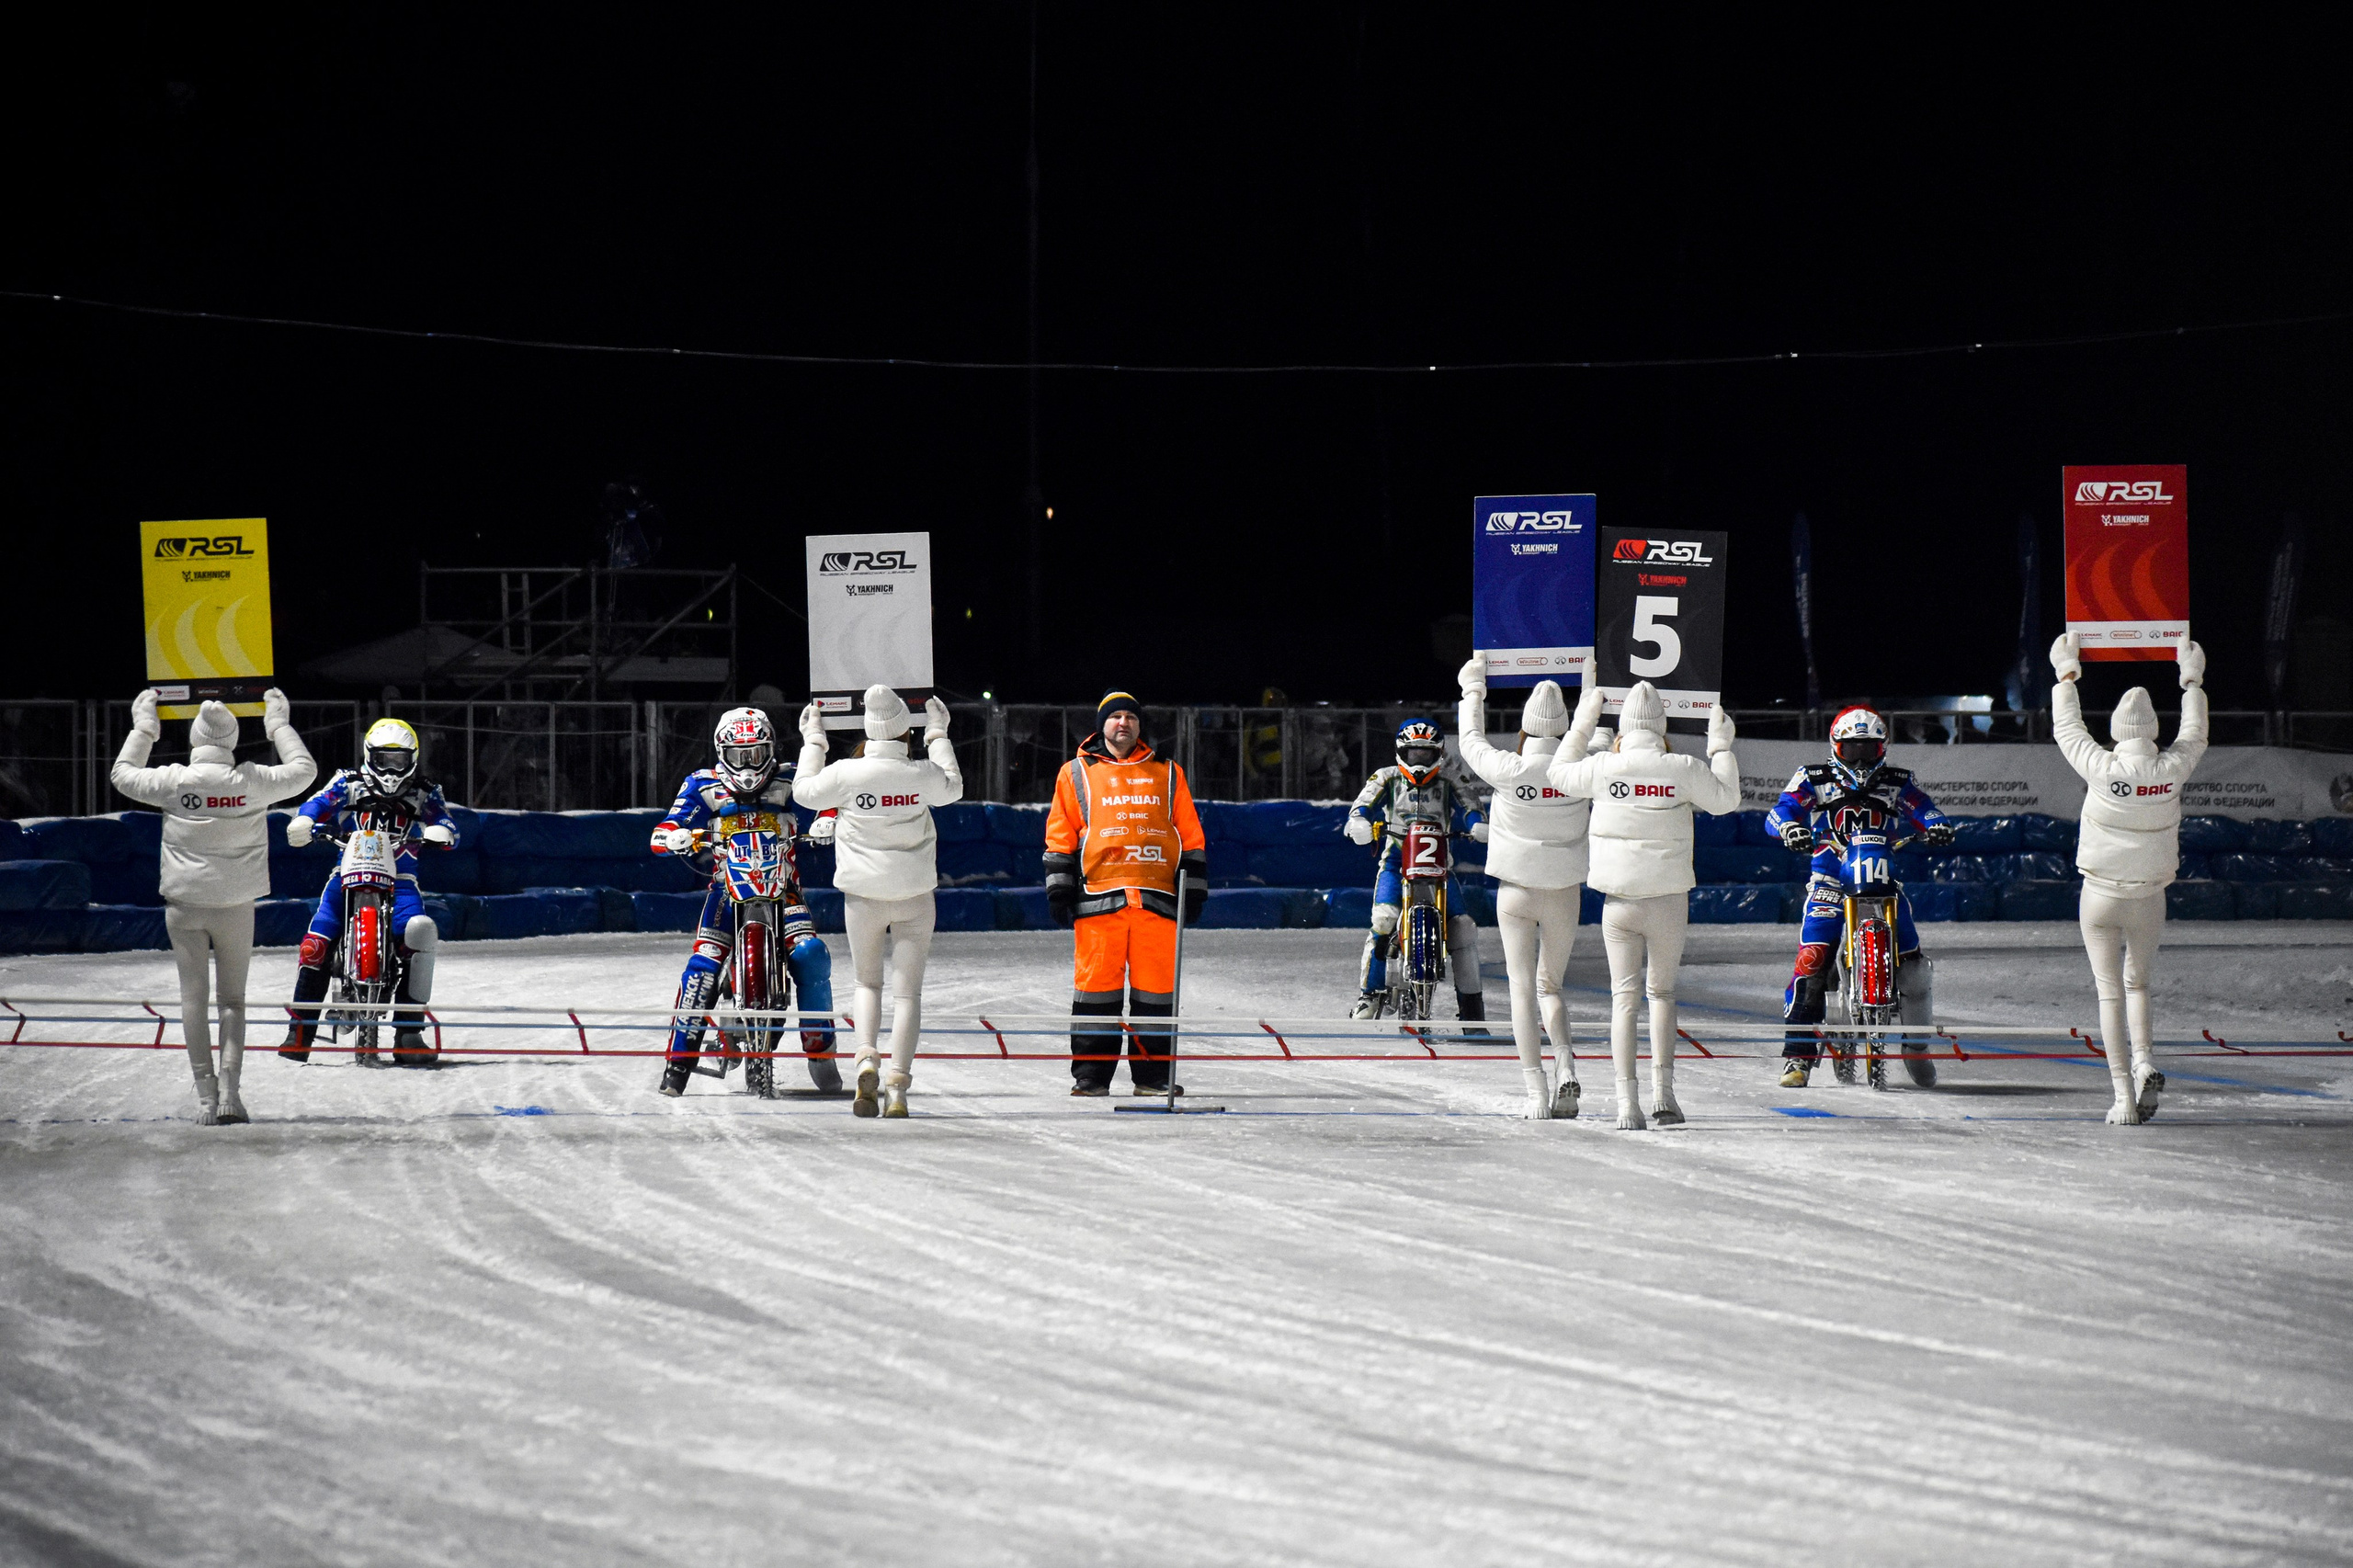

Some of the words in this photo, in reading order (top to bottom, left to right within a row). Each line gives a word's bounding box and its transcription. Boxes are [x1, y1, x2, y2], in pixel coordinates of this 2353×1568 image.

[2108, 481, 2174, 501] RSL
[1518, 510, 1583, 530] RSL
[2113, 515, 2150, 523] YAKHNICH
[188, 536, 256, 557] RSL
[1522, 543, 1559, 552] YAKHNICH
[1646, 540, 1713, 562] RSL
[851, 551, 917, 571] RSL
[193, 570, 231, 580] YAKHNICH
[857, 584, 893, 594] YAKHNICH
[1630, 595, 1682, 678] 5
[1634, 784, 1676, 798] BAIC
[1991, 781, 2029, 791] СПОРТА
[2136, 783, 2174, 797] BAIC
[2225, 783, 2268, 793] СПОРТА
[207, 795, 246, 808] BAIC
[881, 793, 920, 807] BAIC
[1101, 795, 1160, 806] МАРШАЛ
[1979, 796, 2038, 807] ФЕДЕРАЦИИ
[2213, 798, 2275, 809] ФЕДЕРАЦИИ
[1123, 845, 1167, 862] RSL
[1415, 837, 1438, 863] 2
[1850, 858, 1890, 884] 114
[1817, 889, 1841, 898] COOL
